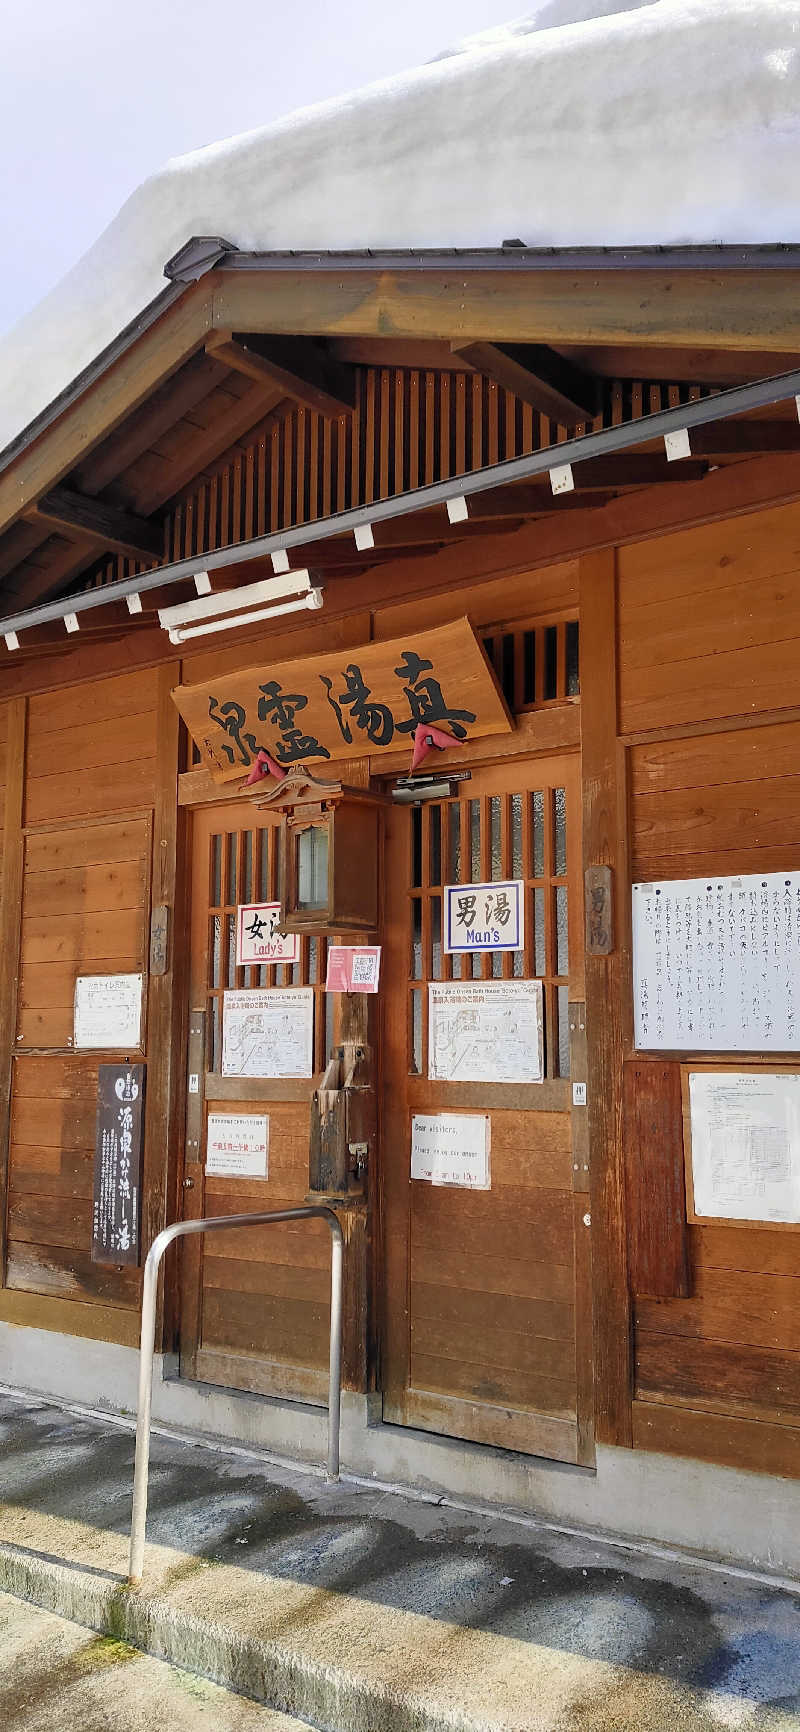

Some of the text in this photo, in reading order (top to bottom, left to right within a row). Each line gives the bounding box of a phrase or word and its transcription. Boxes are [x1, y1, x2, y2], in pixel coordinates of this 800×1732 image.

[456, 892, 511, 928] 男湯
[590, 886, 608, 947] 男湯
[253, 940, 284, 957] Lady's
[466, 927, 500, 944] Man's
